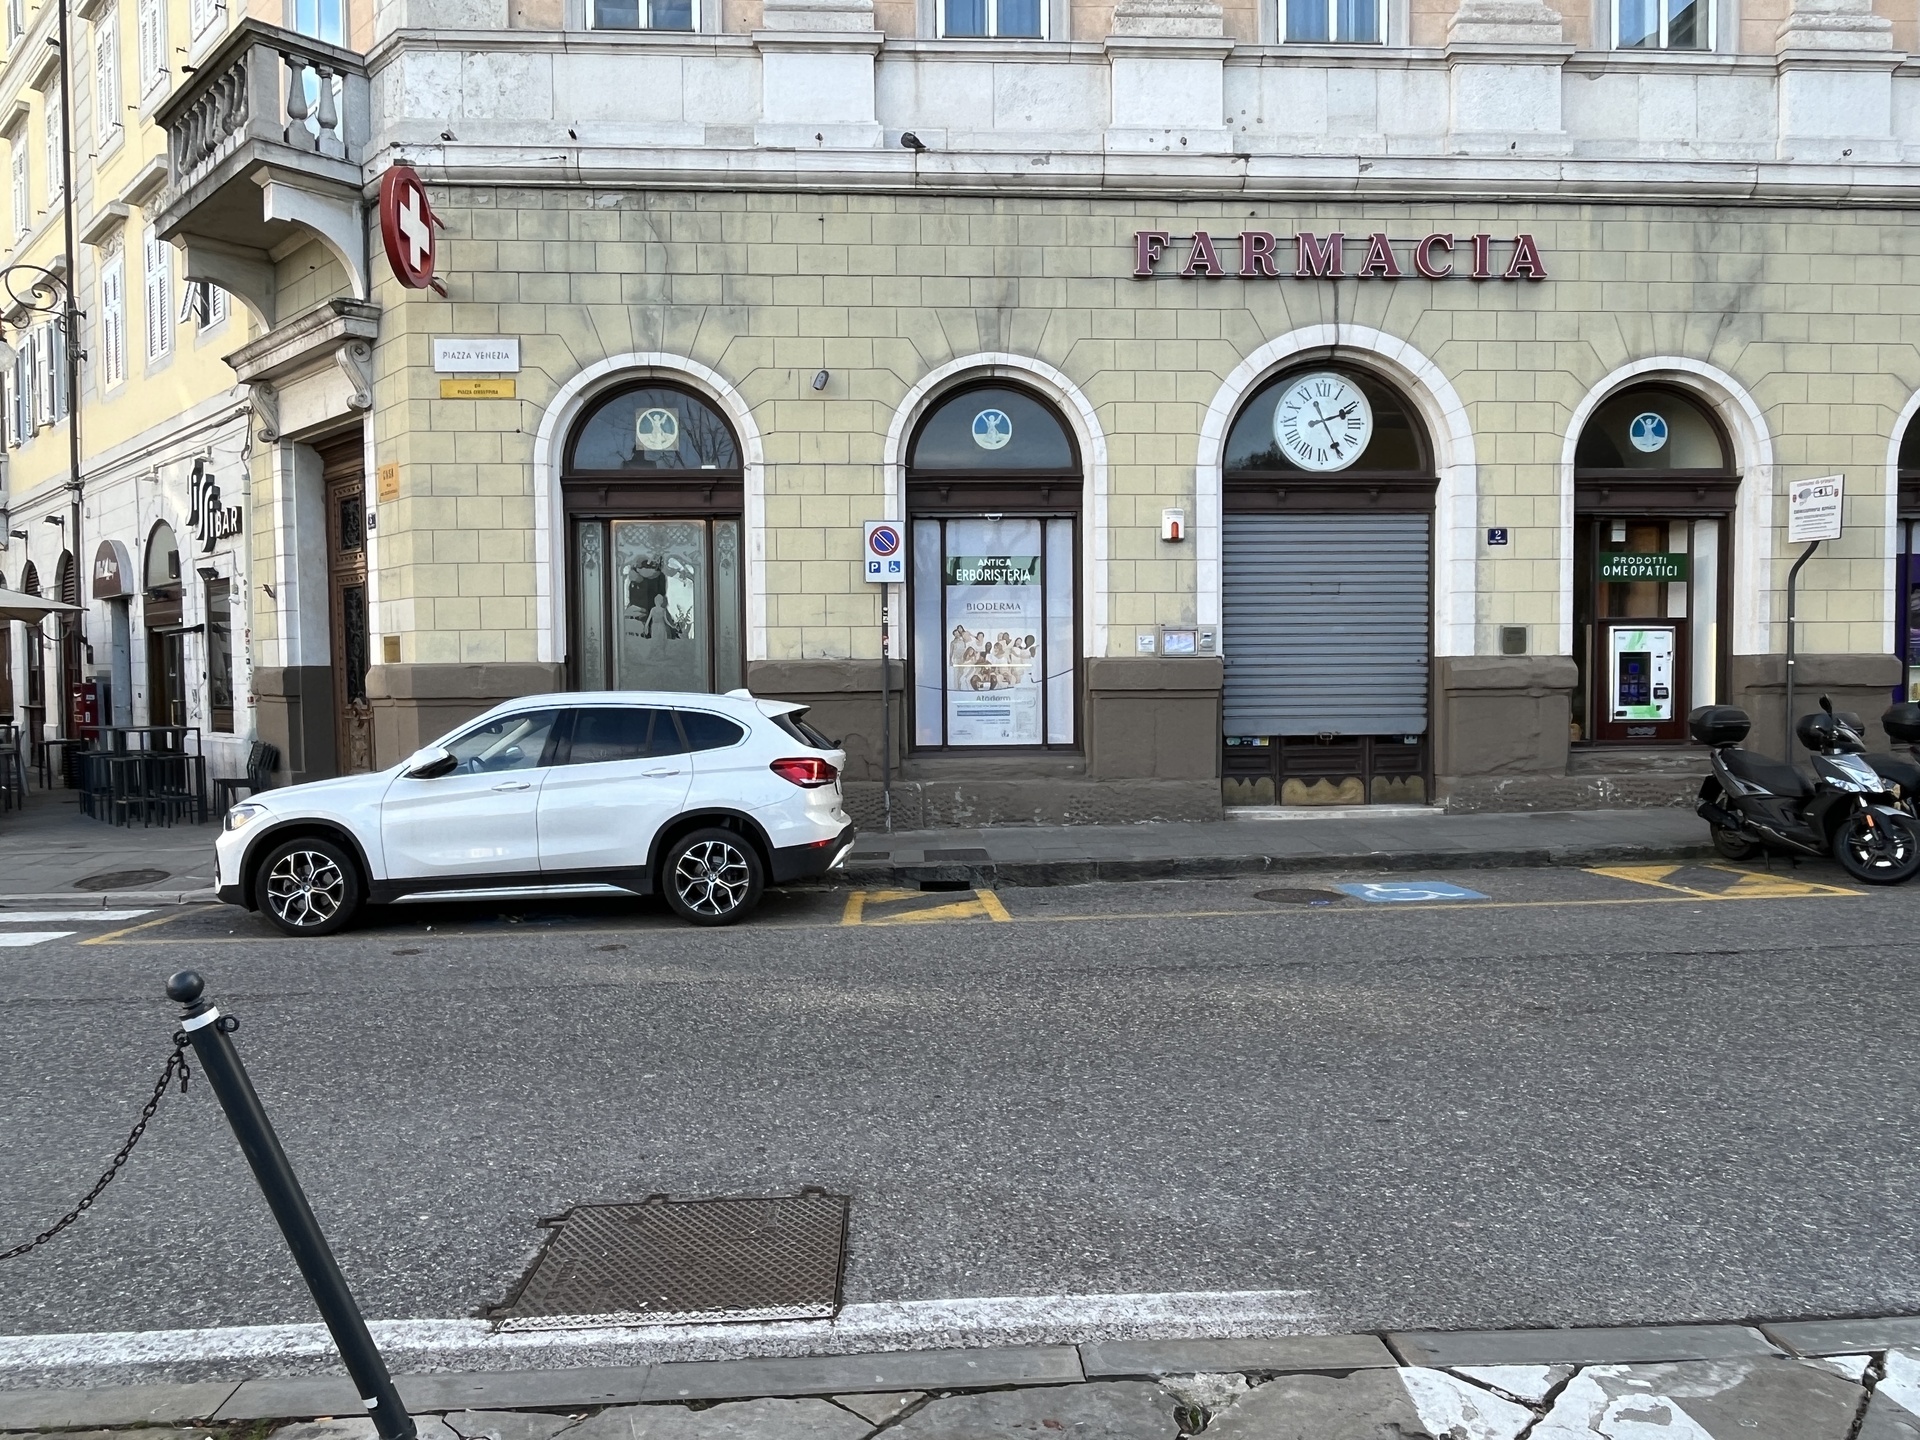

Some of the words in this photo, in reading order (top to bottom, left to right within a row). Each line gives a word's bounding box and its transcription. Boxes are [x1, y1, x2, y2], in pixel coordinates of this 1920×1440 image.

[1133, 231, 1548, 280] FARMACIA
[442, 351, 472, 360] PIAZZA
[474, 351, 510, 360] VENEZIA
[215, 505, 241, 539] BAR
[1495, 529, 1502, 540] 2
[977, 558, 1012, 567] ANTICA
[1613, 556, 1667, 564] PRODOTTI
[871, 562, 879, 573] P
[1603, 565, 1678, 576] OMEOPATICI
[956, 568, 1031, 581] ERBORISTERIA
[966, 602, 1021, 611] BIODERMA
